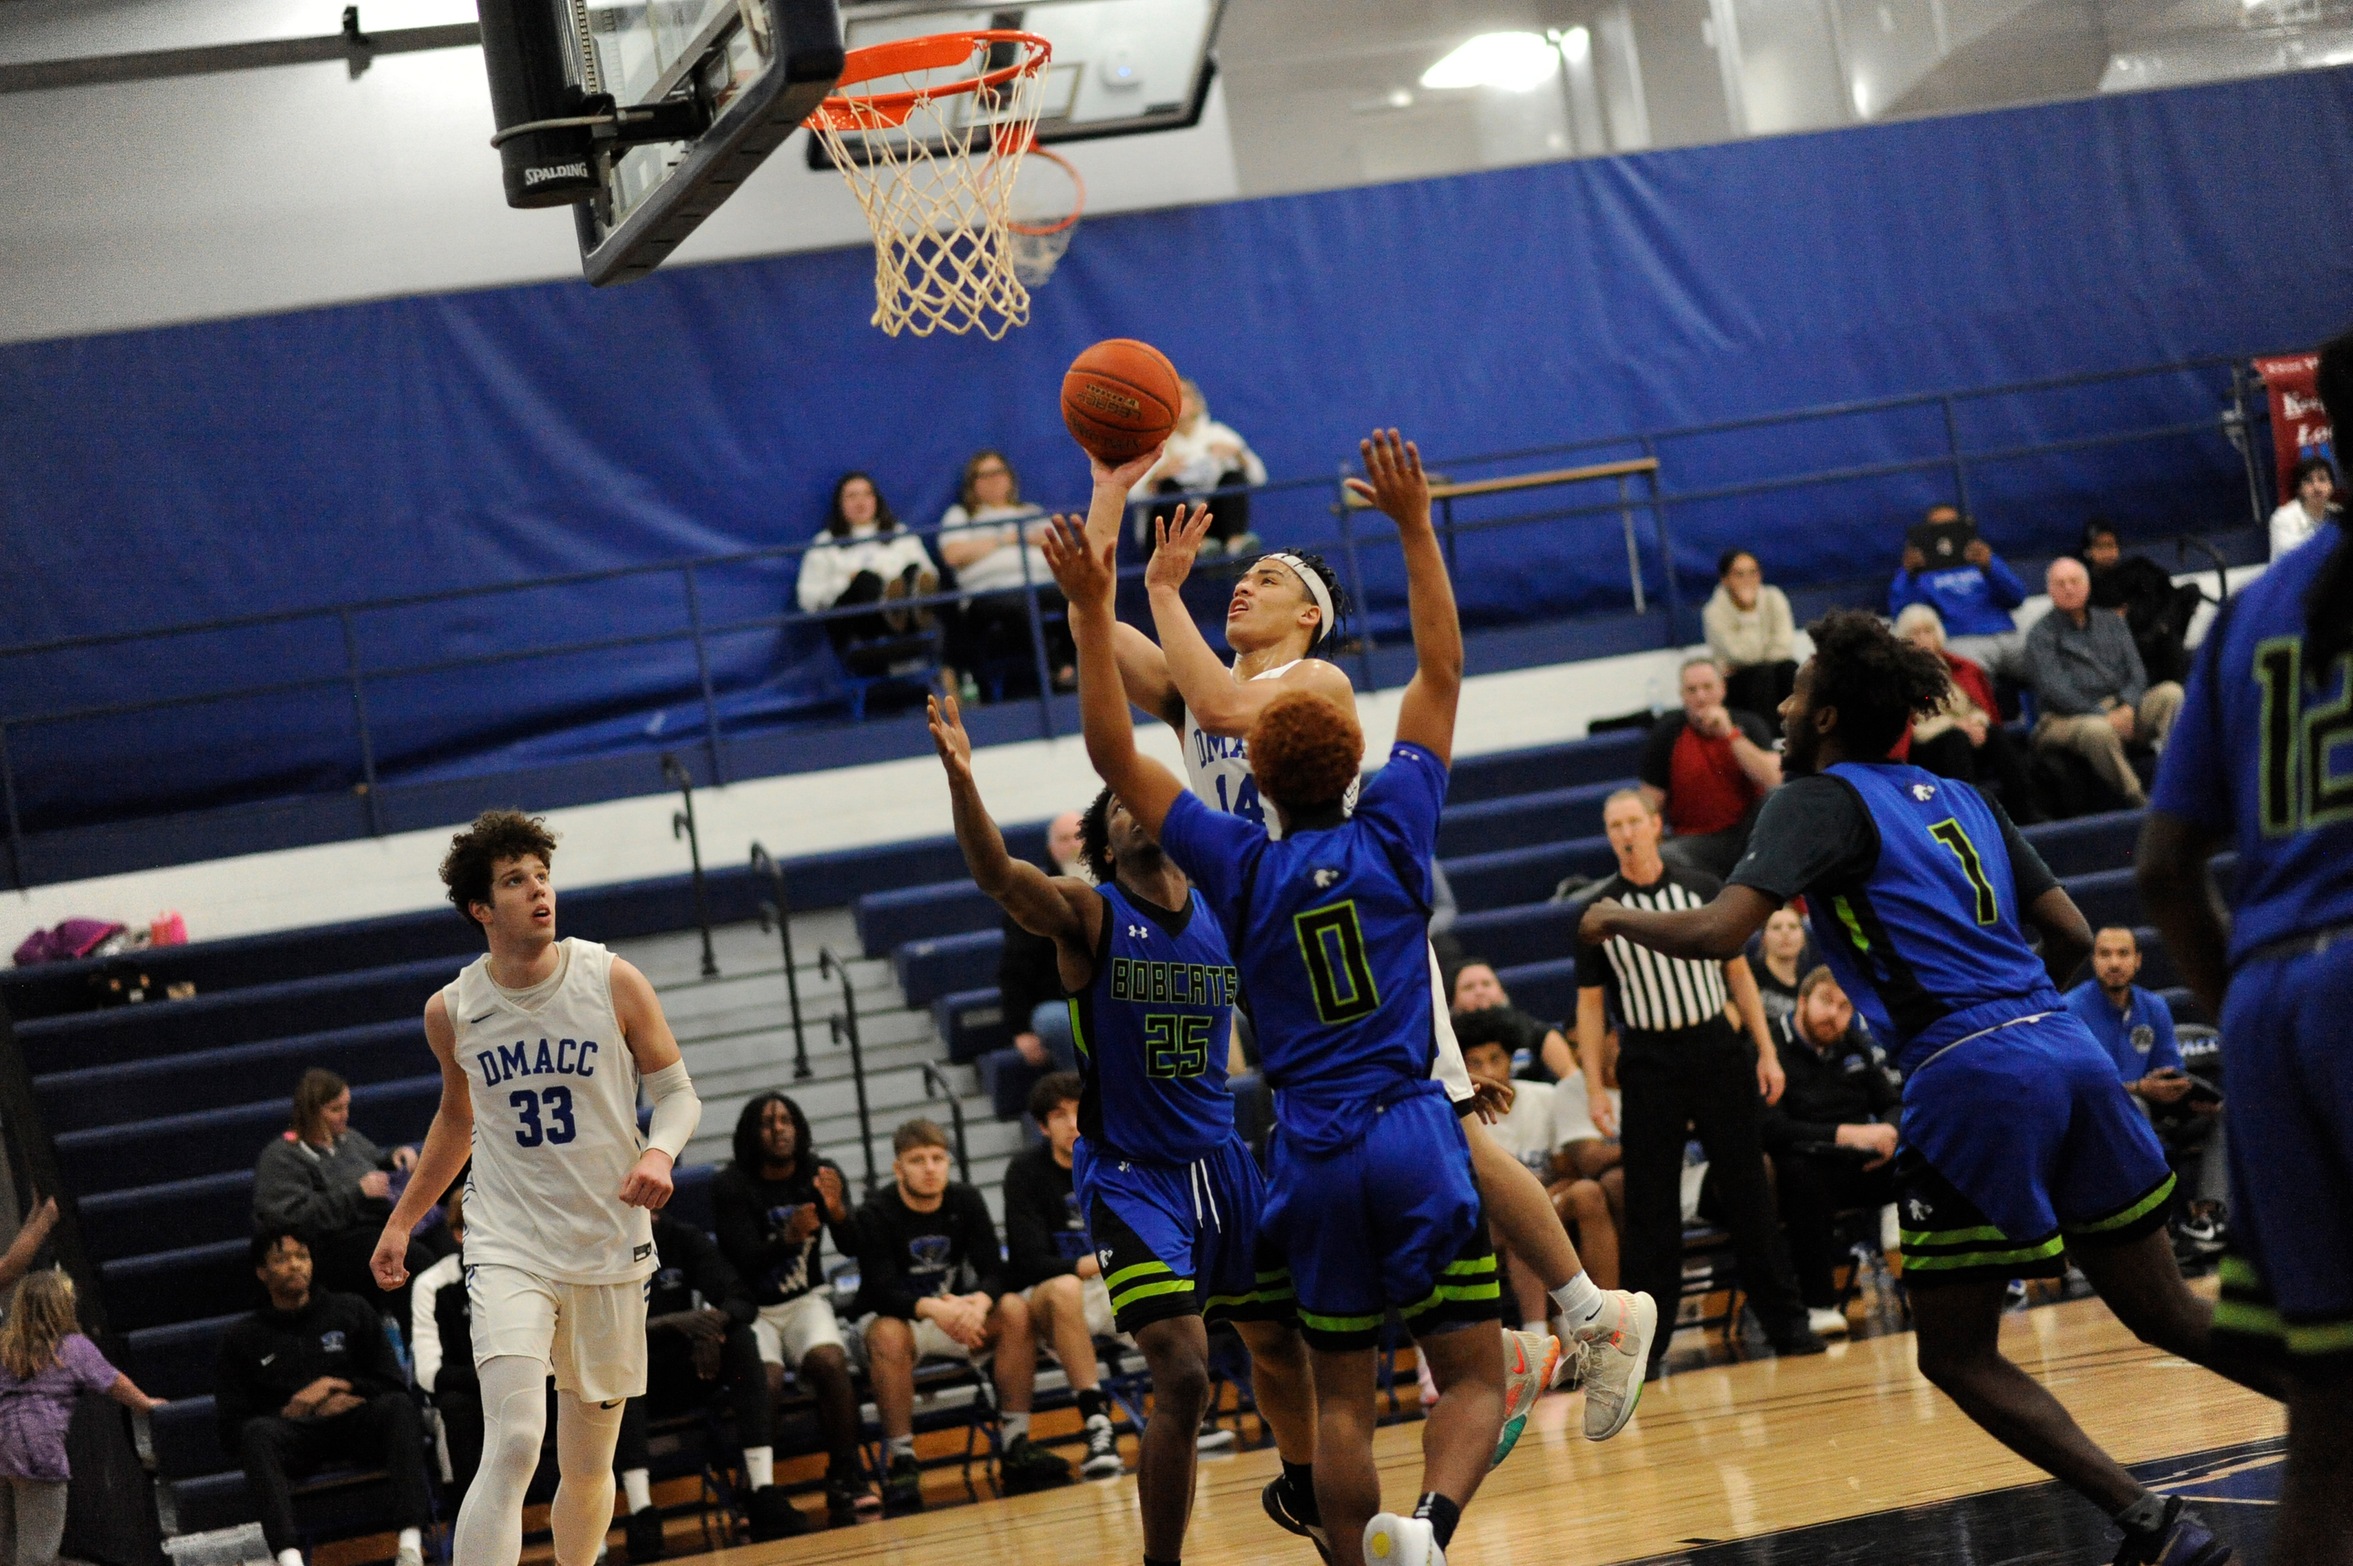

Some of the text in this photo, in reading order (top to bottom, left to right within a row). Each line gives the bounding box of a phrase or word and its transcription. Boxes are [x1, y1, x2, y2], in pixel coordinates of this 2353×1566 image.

[525, 162, 588, 186] SPALDING
[1194, 728, 1249, 769] DMA
[1215, 773, 1266, 828] 14
[1926, 817, 1998, 925] 1
[1111, 957, 1238, 1007] BOBCATS
[477, 1038, 598, 1087] DMACC
[1145, 1014, 1213, 1079] 25
[509, 1085, 577, 1148] 33
